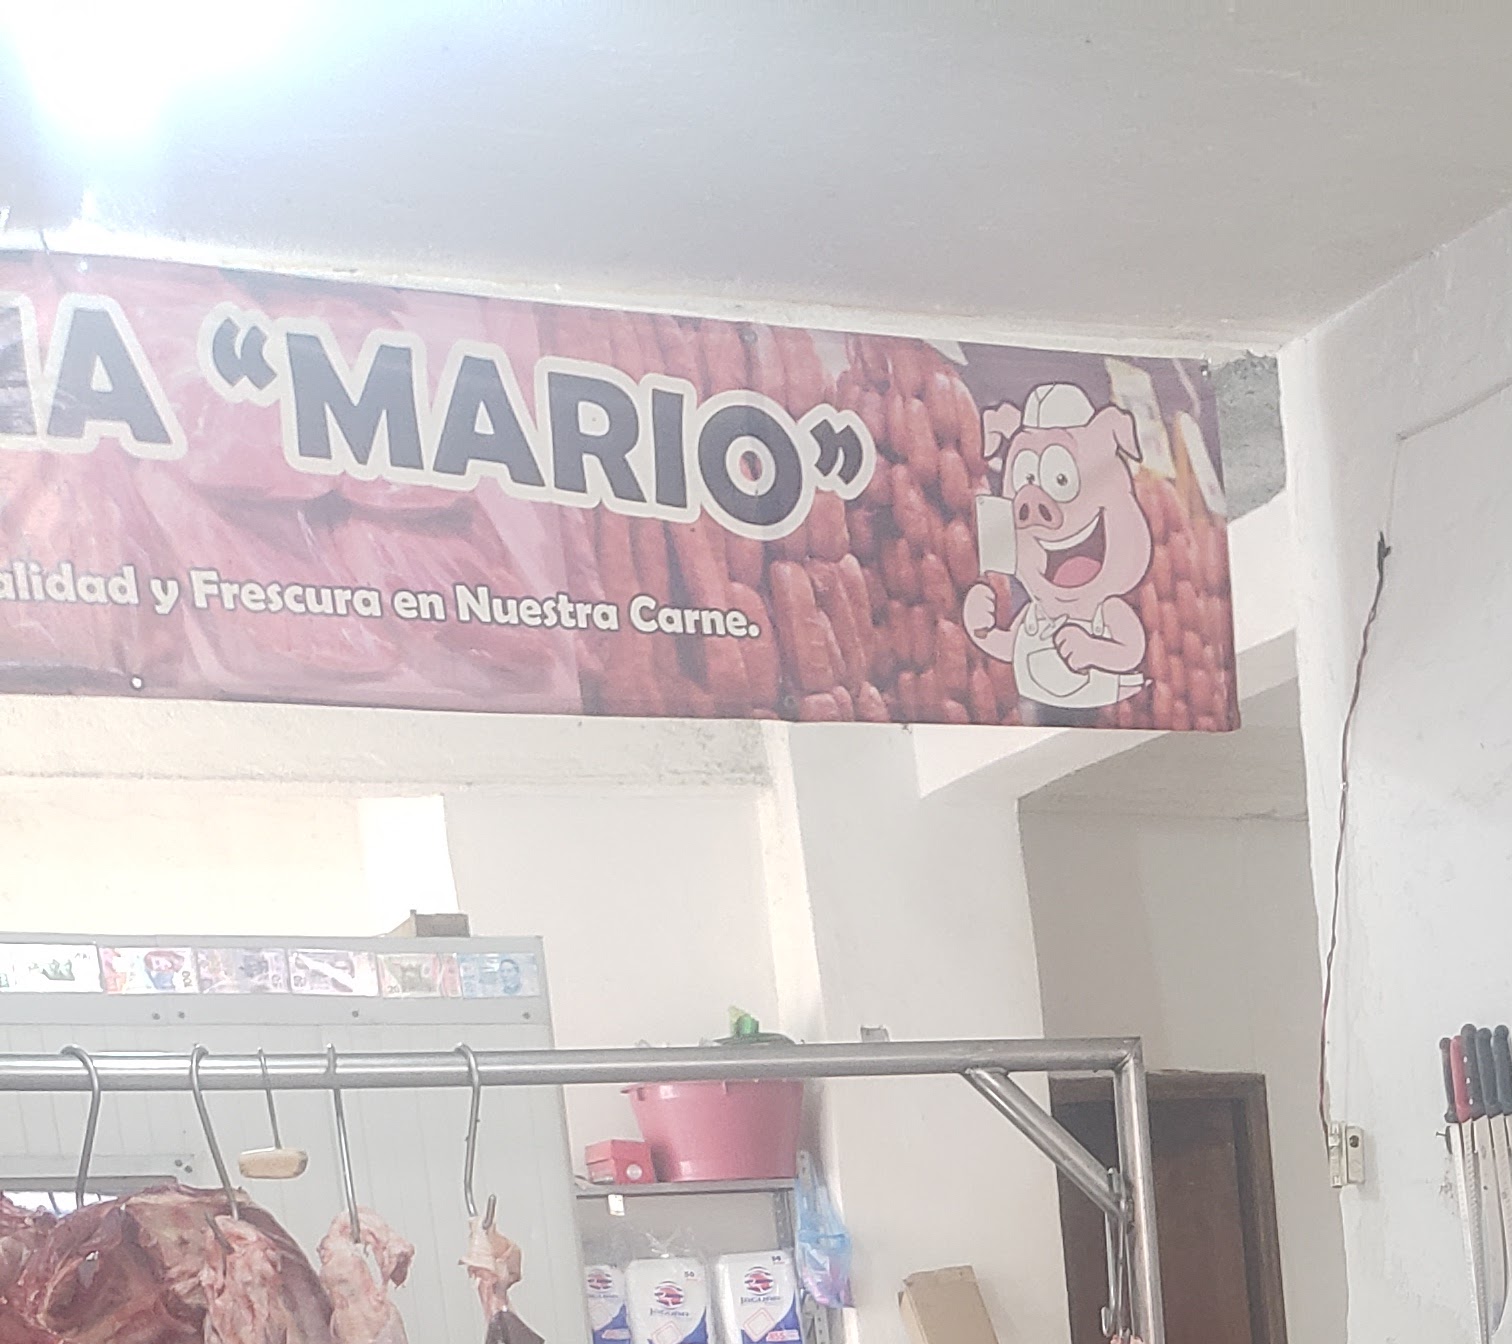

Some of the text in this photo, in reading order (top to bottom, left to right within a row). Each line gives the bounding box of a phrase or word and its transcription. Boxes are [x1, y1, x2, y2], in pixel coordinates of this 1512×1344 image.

[149, 576, 180, 616] y
[189, 568, 382, 618] Frescura
[393, 589, 446, 621] en
[454, 584, 620, 632] Nuestra
[629, 595, 761, 638] Carne.
